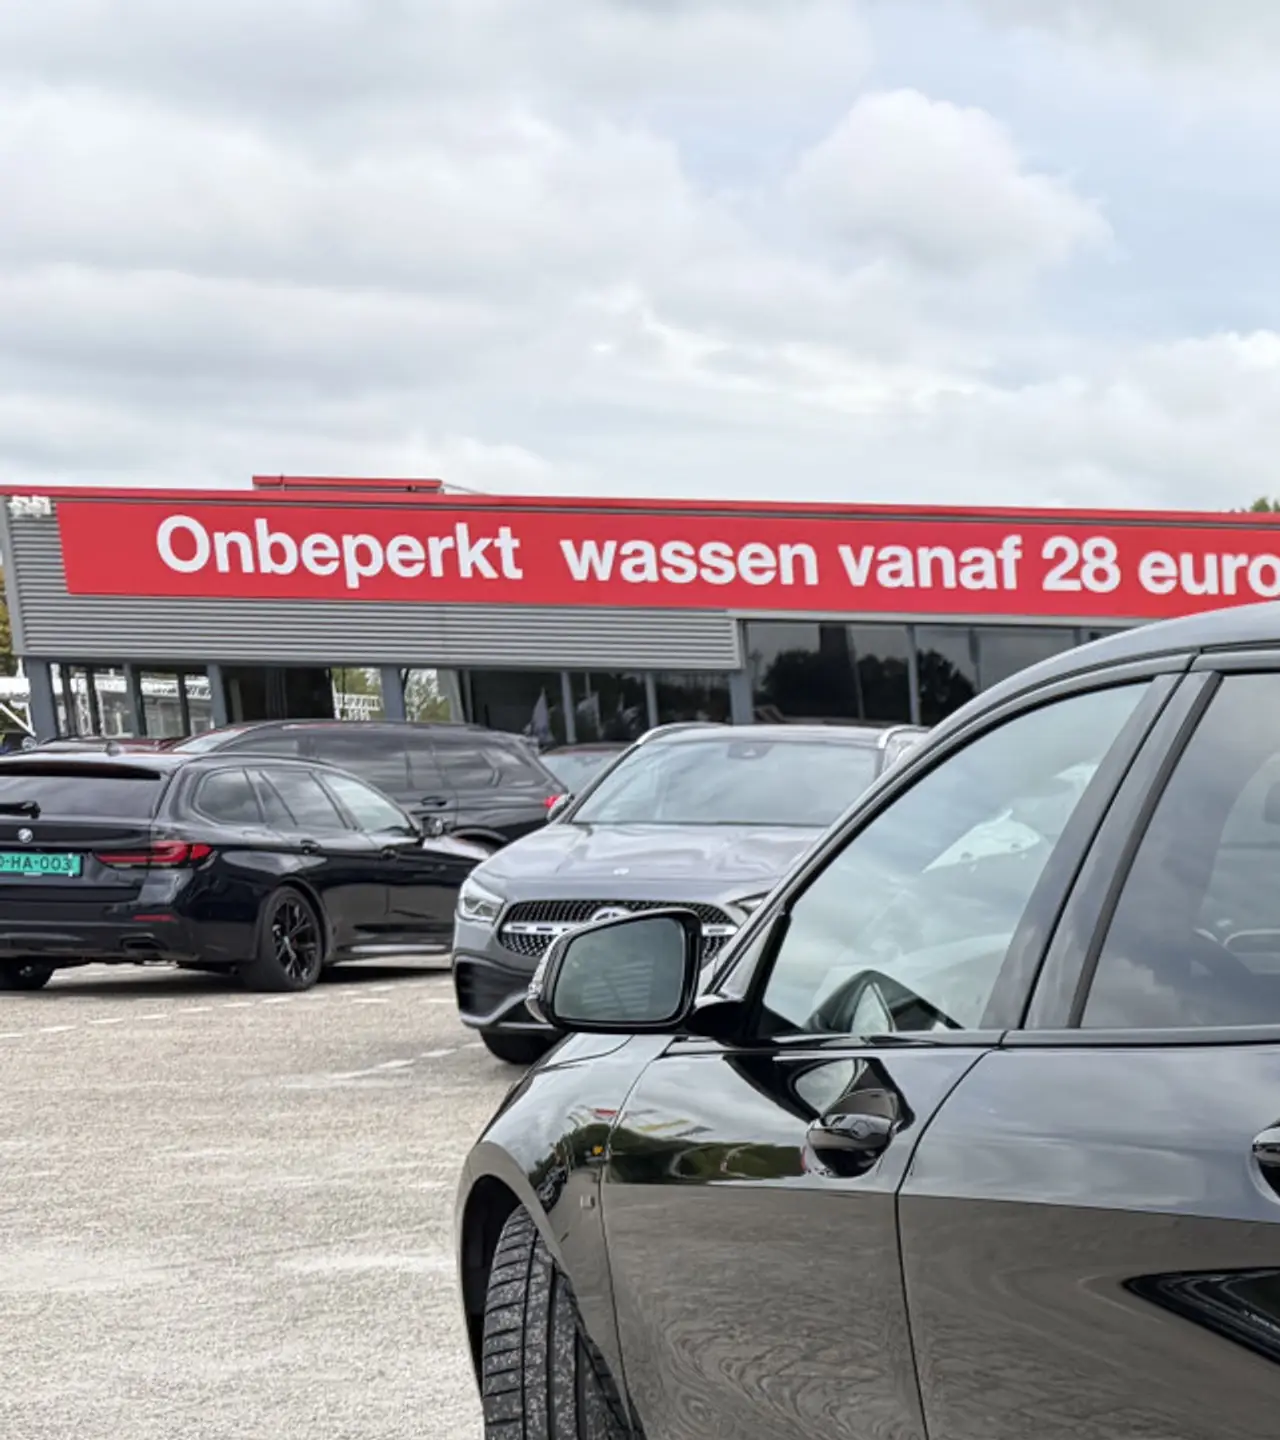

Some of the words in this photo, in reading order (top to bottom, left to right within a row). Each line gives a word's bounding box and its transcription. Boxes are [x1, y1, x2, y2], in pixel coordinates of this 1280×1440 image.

[156, 514, 523, 588] Onbeperkt
[560, 539, 819, 586] wassen
[839, 535, 1023, 591] vanaf
[1041, 536, 1121, 593] 28
